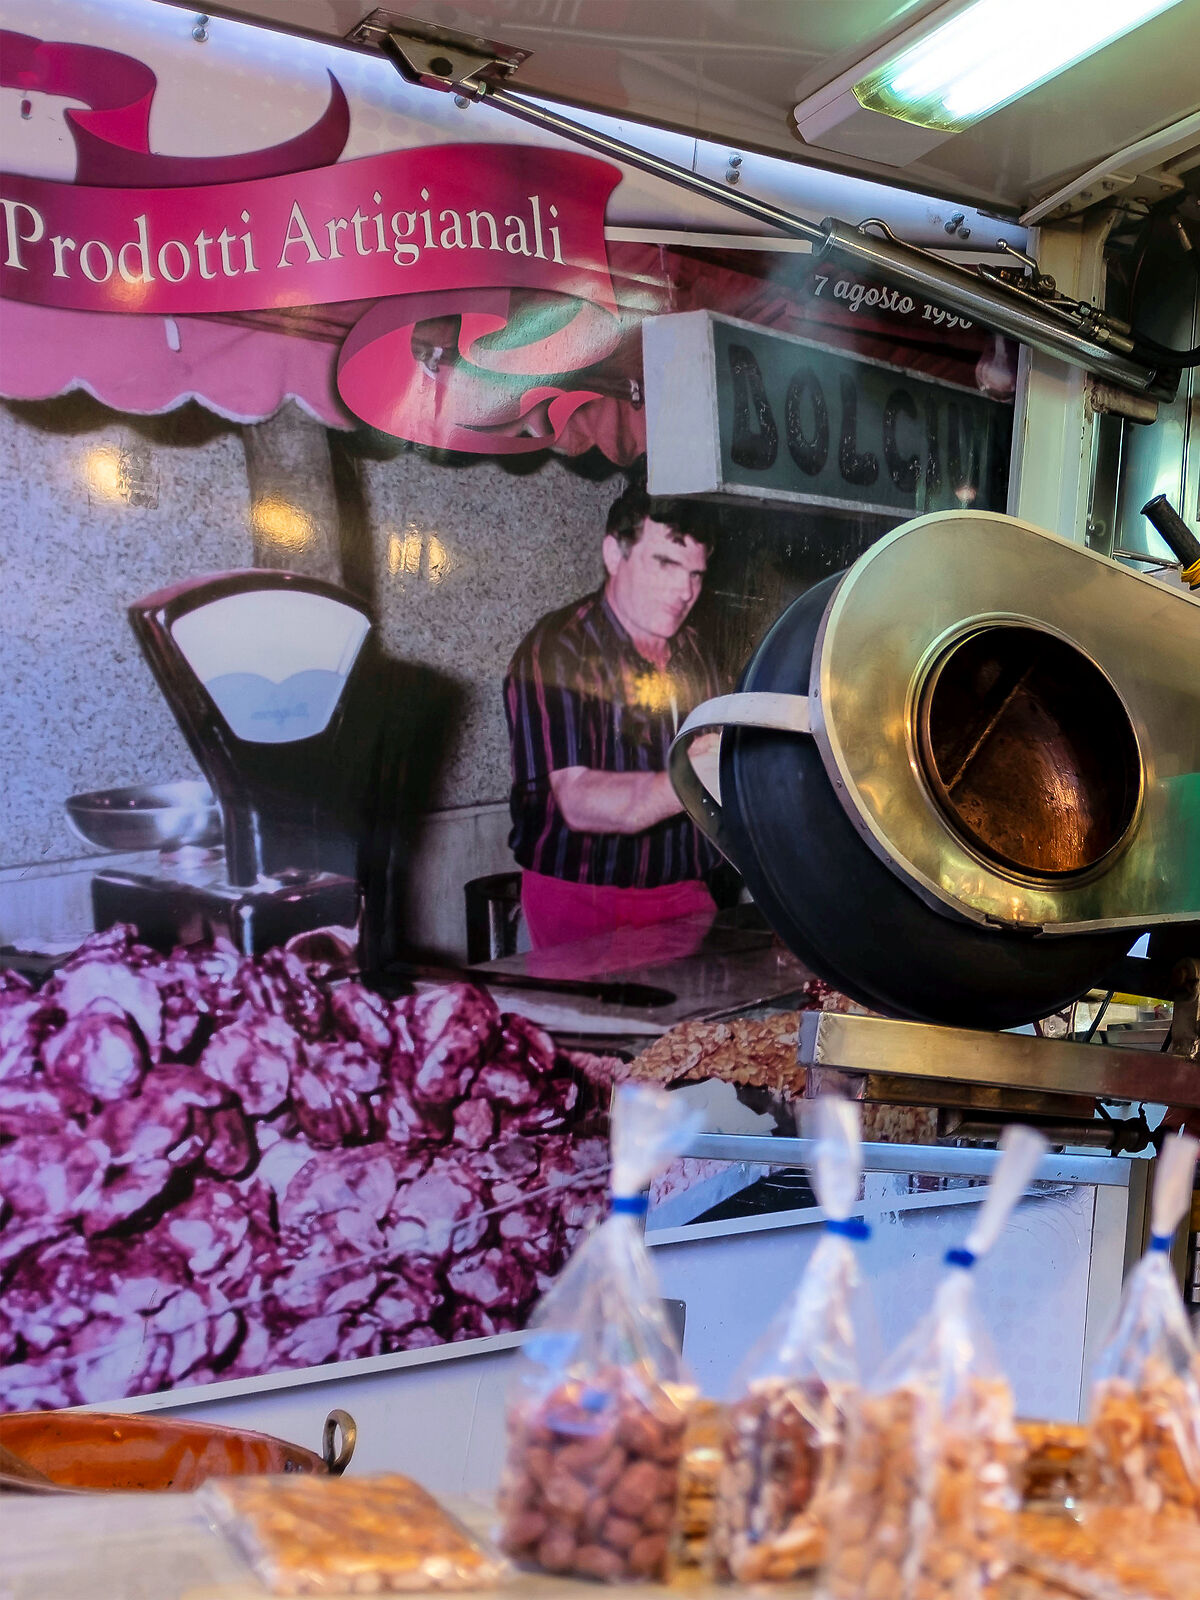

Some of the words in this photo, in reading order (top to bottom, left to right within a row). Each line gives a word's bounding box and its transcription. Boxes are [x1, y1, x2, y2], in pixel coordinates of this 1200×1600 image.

[2, 198, 259, 285] Prodotti
[277, 187, 568, 268] Artigianali
[814, 274, 829, 296] 7
[833, 279, 916, 312] agosto
